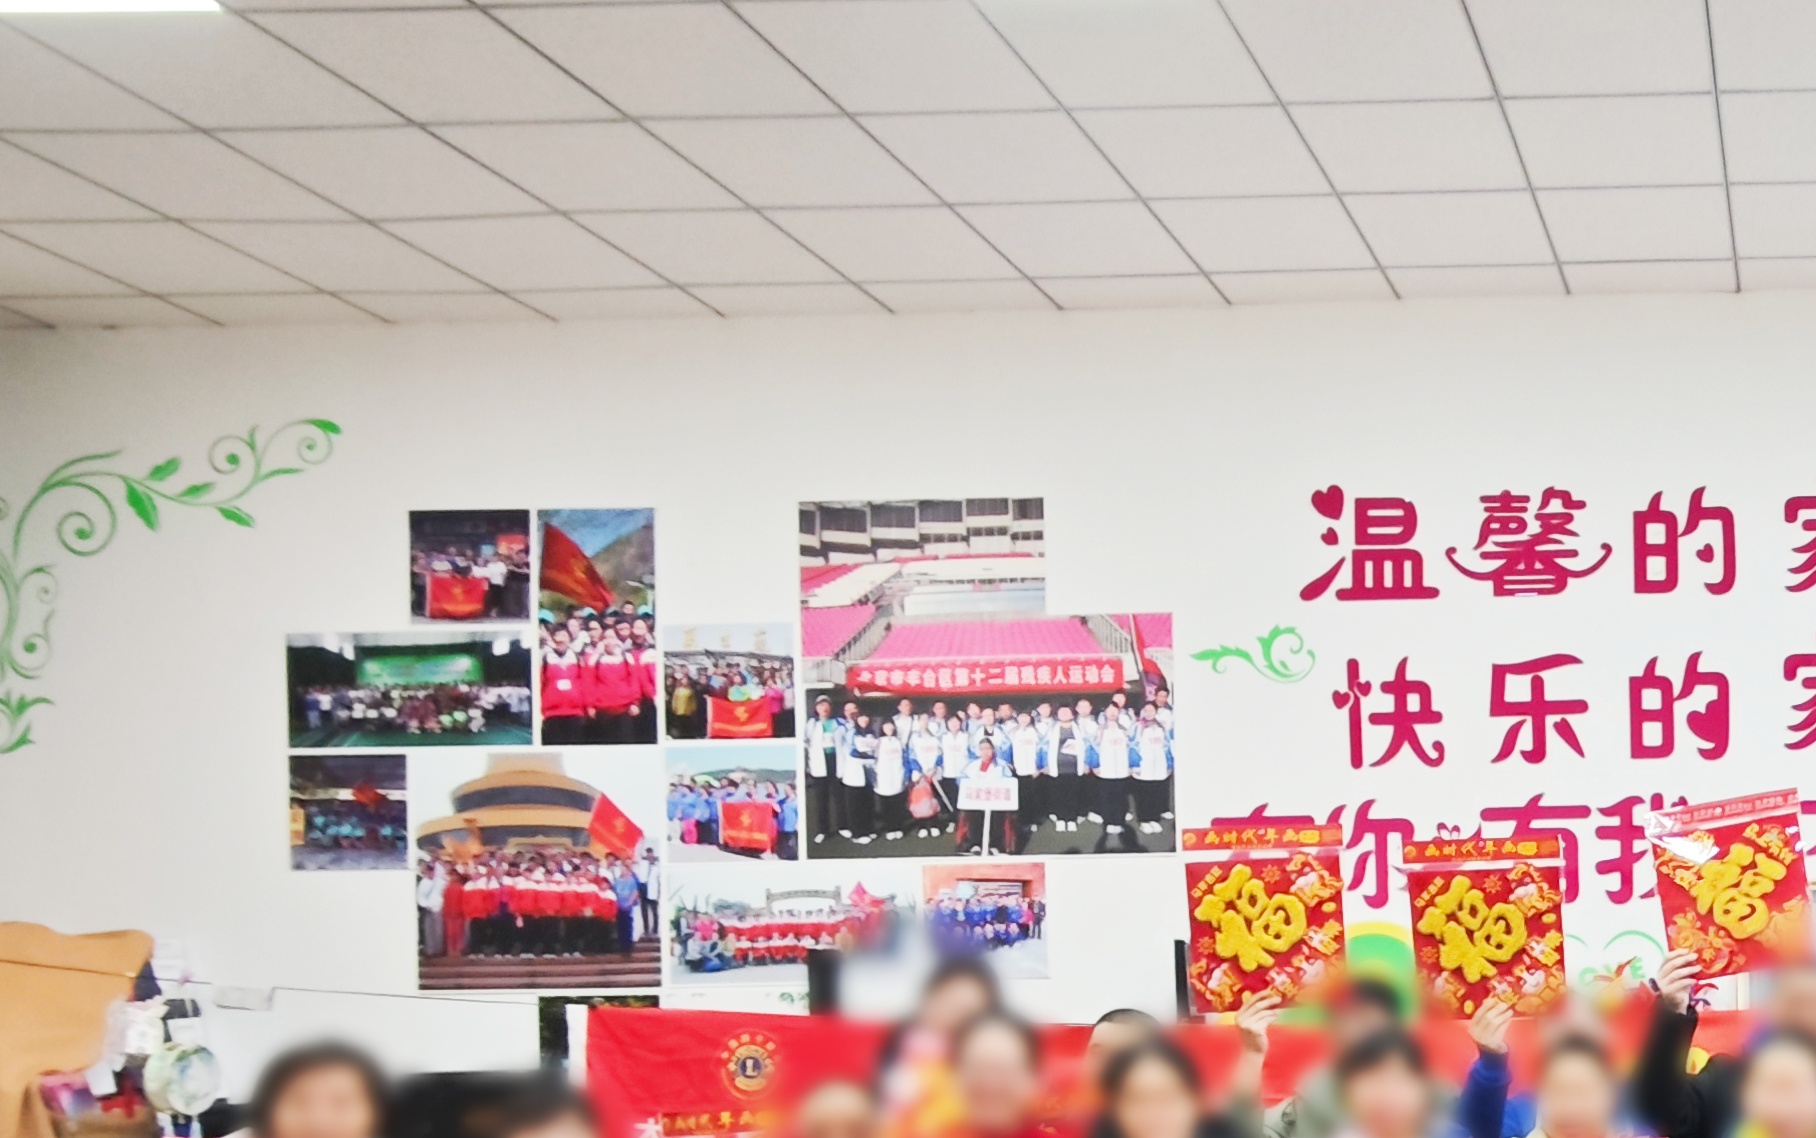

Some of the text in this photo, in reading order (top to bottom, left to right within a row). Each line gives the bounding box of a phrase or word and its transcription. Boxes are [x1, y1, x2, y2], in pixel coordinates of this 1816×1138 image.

[1194, 864, 1308, 972] 福
[1417, 875, 1527, 983] 福
[1692, 843, 1787, 940] 福
